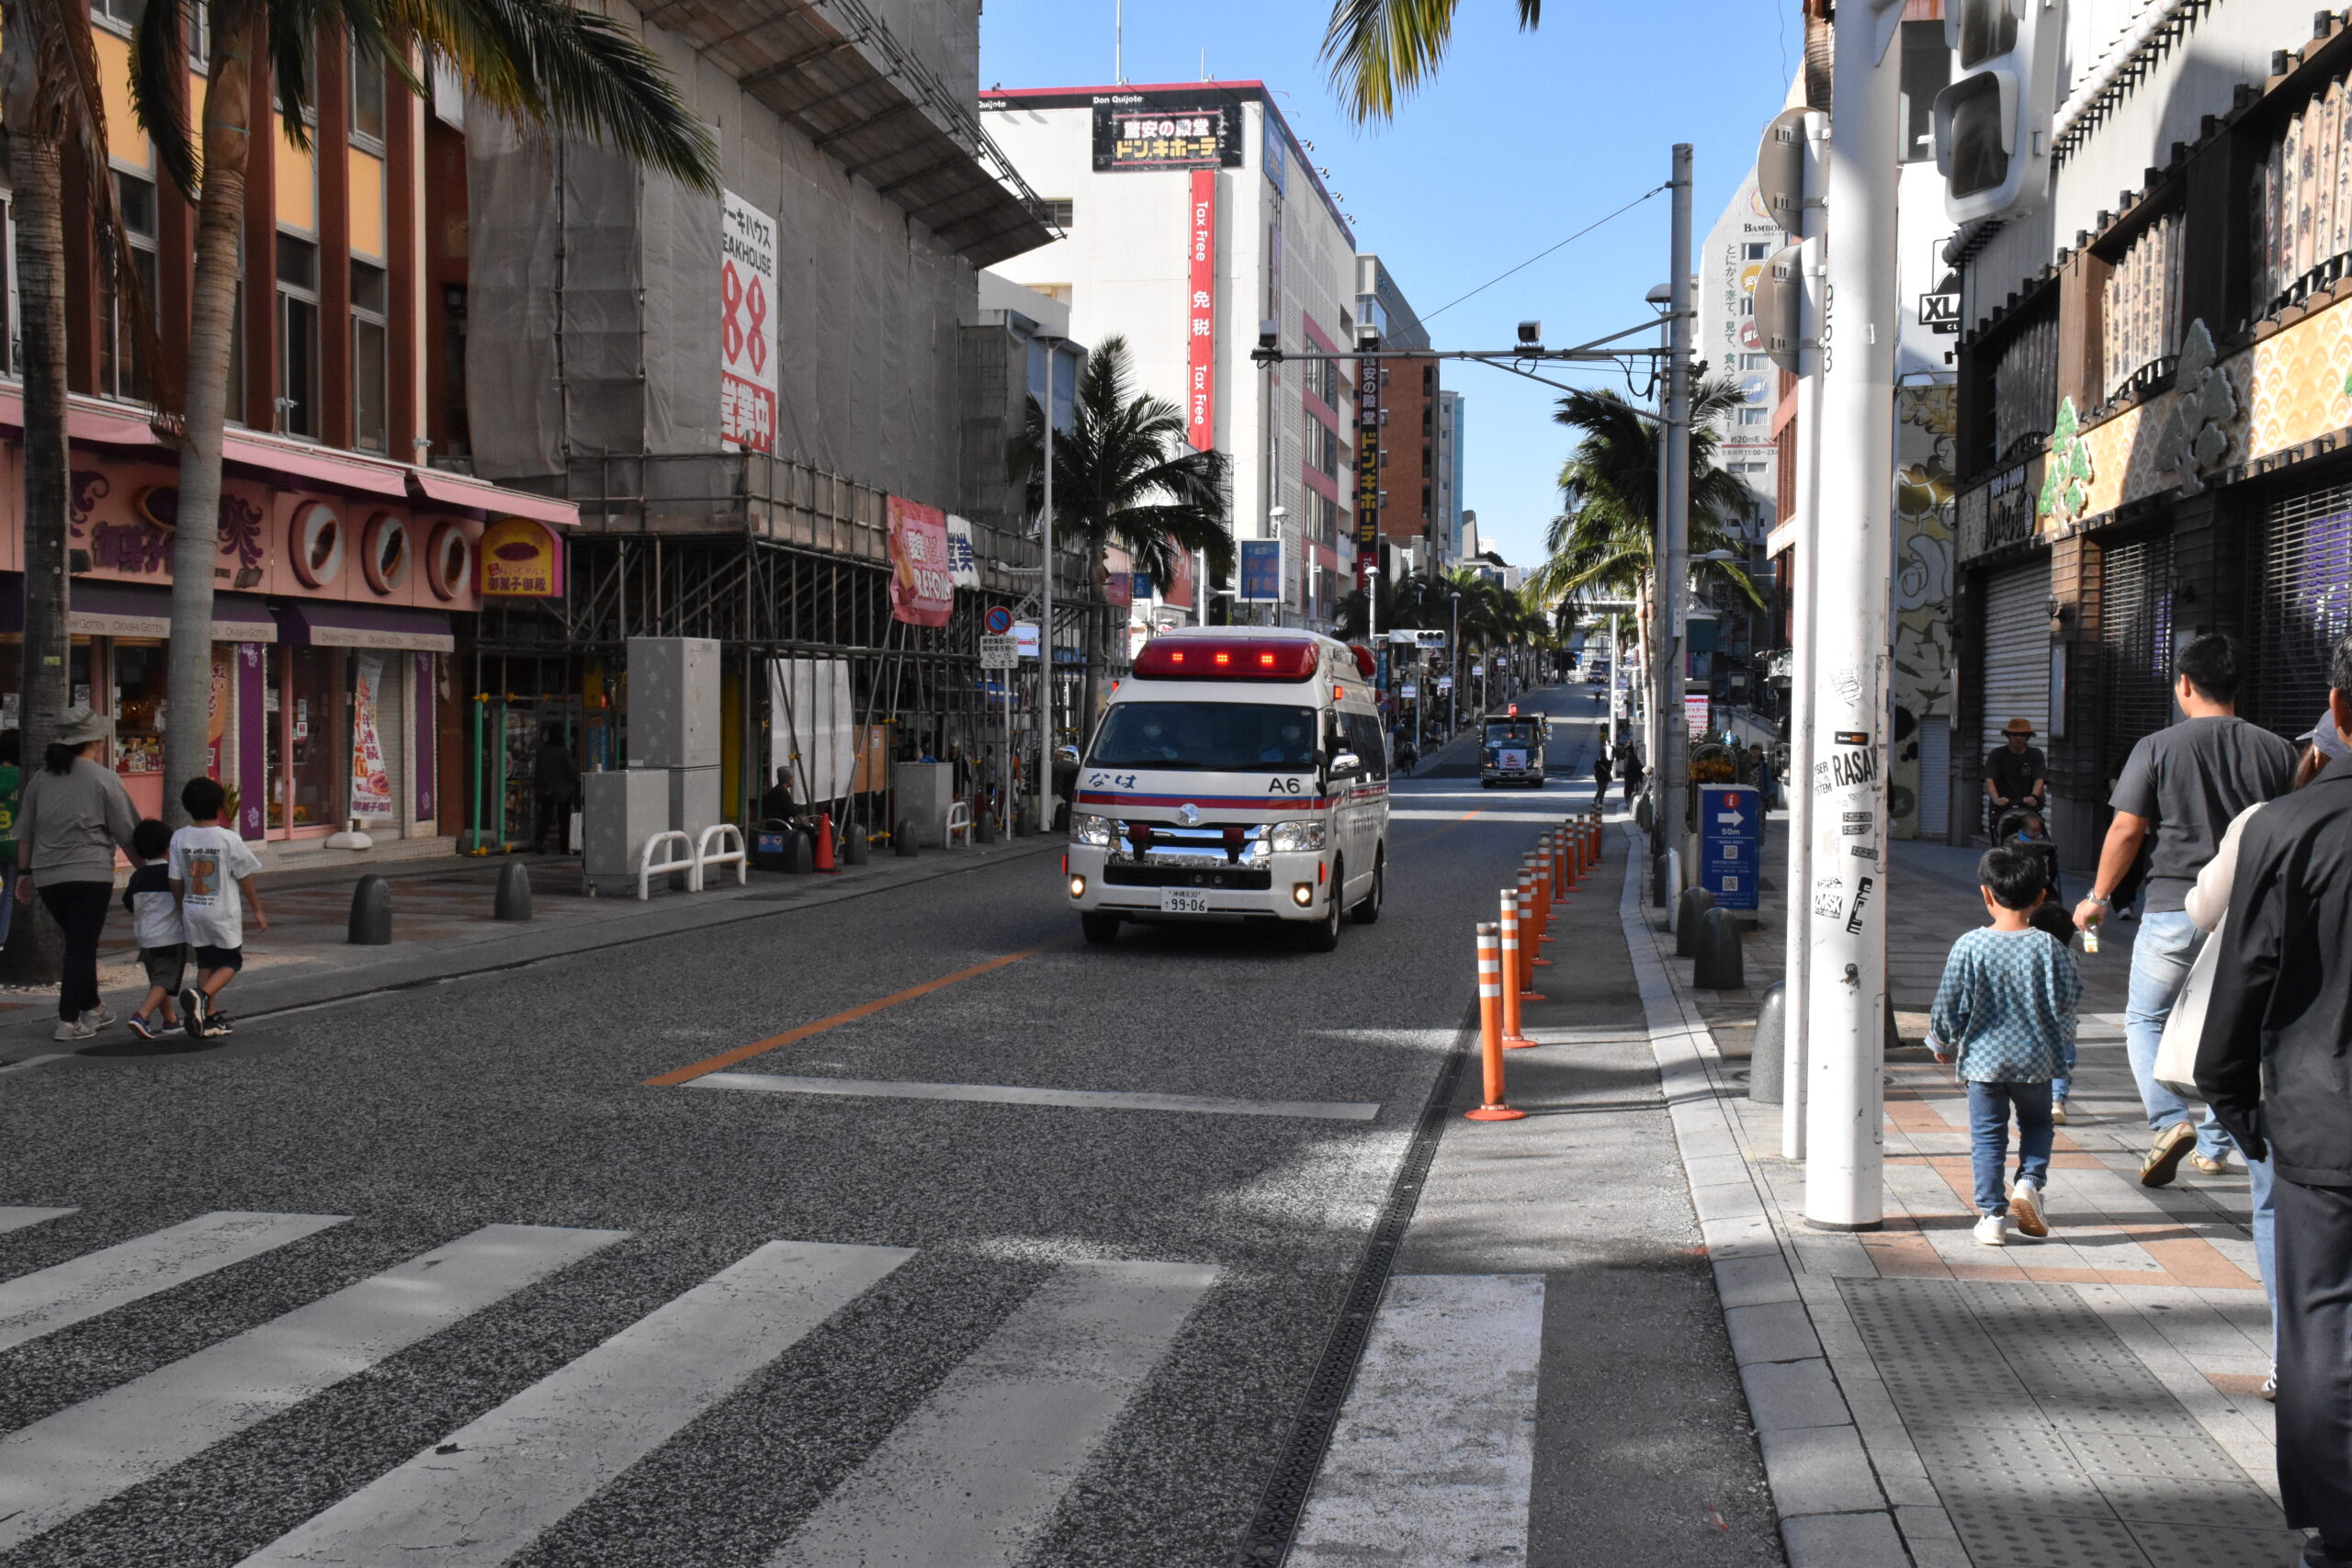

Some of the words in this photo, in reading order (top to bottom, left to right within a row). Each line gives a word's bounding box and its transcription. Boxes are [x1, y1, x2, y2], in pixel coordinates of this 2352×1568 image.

[1093, 96, 1110, 104] Don
[1112, 95, 1143, 105] Quijote
[1123, 118, 1209, 139] 驚安の殿堂
[1196, 201, 1208, 226] Tax
[1196, 231, 1208, 262] Free
[722, 259, 767, 377] 88
[1193, 291, 1210, 336] 免税
[1194, 365, 1207, 390] Tax
[722, 378, 771, 447] 営業中
[1194, 393, 1207, 425] Free
[1363, 557, 1372, 575] Ta
[80, 619, 106, 631] GOTEN
[112, 620, 139, 632] OKASHI
[141, 622, 165, 633] GOTEN
[225, 626, 247, 637] OKASHI
[248, 627, 269, 638] GOTEN
[1088, 772, 1136, 790] なは
[1268, 778, 1301, 794] A6
[1171, 898, 1205, 911] 99-06
